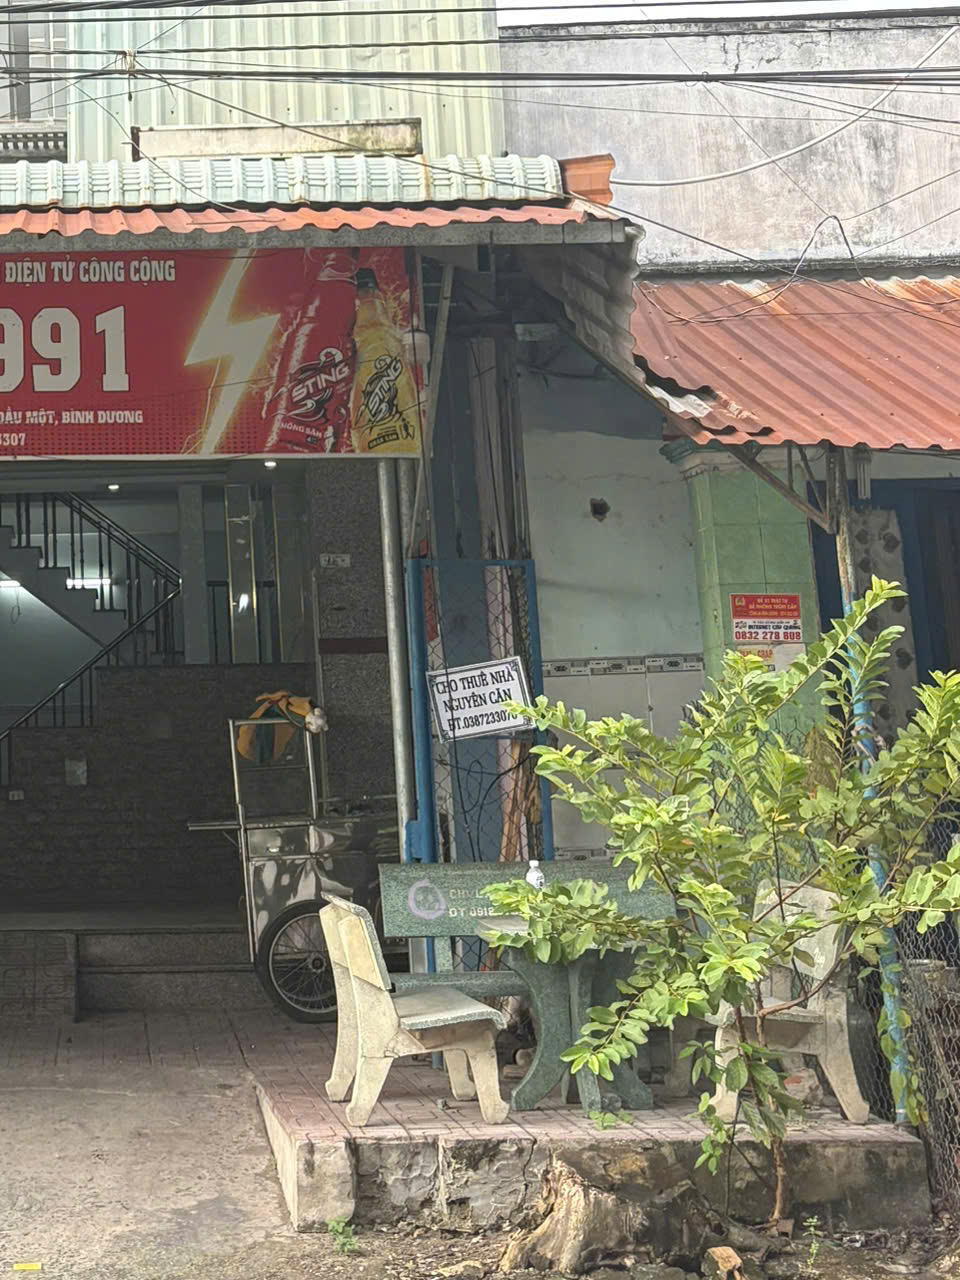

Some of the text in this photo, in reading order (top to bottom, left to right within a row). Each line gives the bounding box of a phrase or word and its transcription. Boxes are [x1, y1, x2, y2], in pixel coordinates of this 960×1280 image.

[5, 258, 46, 287] ĐIỆN
[51, 255, 76, 282] TỬ
[79, 257, 125, 282] CÔNG
[129, 256, 176, 286] CỘNG
[292, 361, 350, 402] STING
[368, 359, 402, 415] STING
[762, 631, 780, 640] 278
[435, 665, 515, 695] CHO THUÊ NHÀ
[443, 688, 513, 713] NGUYÊN CĂN
